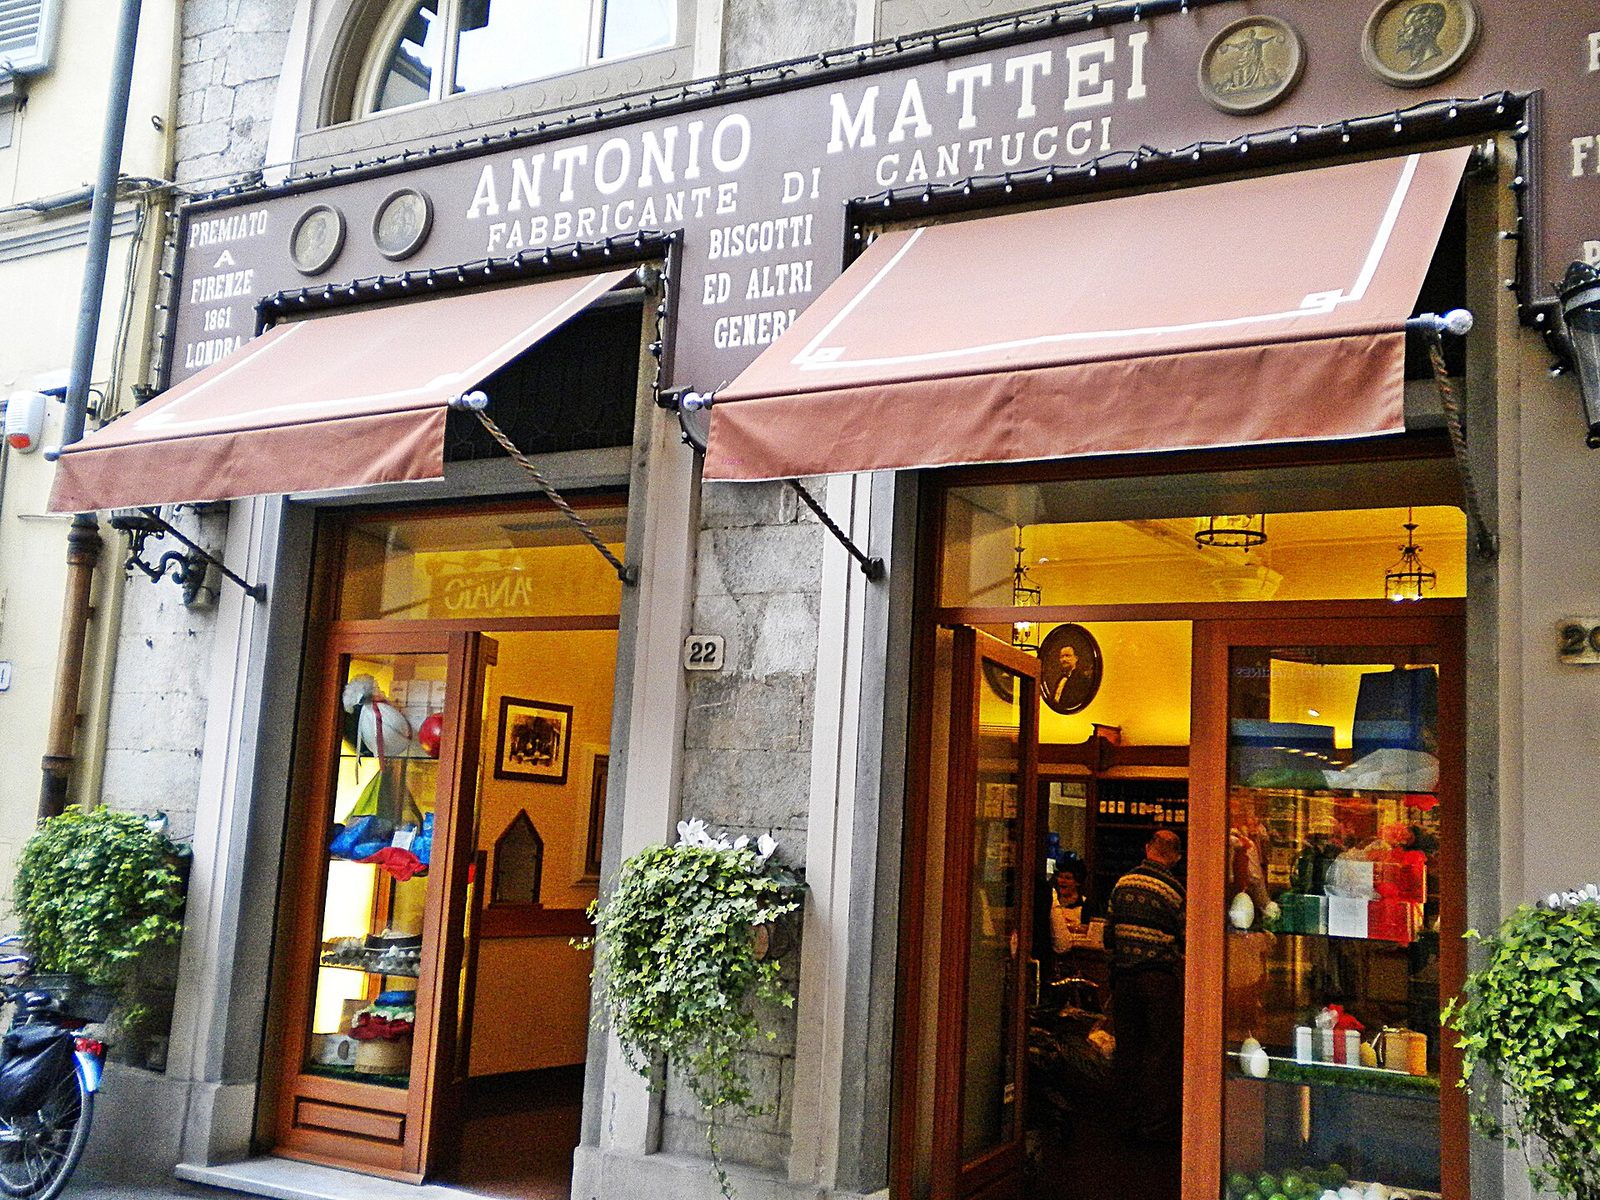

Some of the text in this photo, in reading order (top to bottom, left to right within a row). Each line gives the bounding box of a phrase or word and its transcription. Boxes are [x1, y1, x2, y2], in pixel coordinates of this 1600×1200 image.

[466, 31, 1149, 219] ANTONIO MATTEI
[487, 116, 1112, 251] FABBRICANTE DI CANTUCCI
[190, 209, 268, 248] PREMIATO
[708, 213, 813, 259] BISCOTTI
[213, 250, 236, 268] A
[190, 268, 254, 303] FIRENZE
[702, 260, 813, 305] ED ALTRI
[204, 306, 231, 331] 1861
[689, 642, 716, 662] 22
